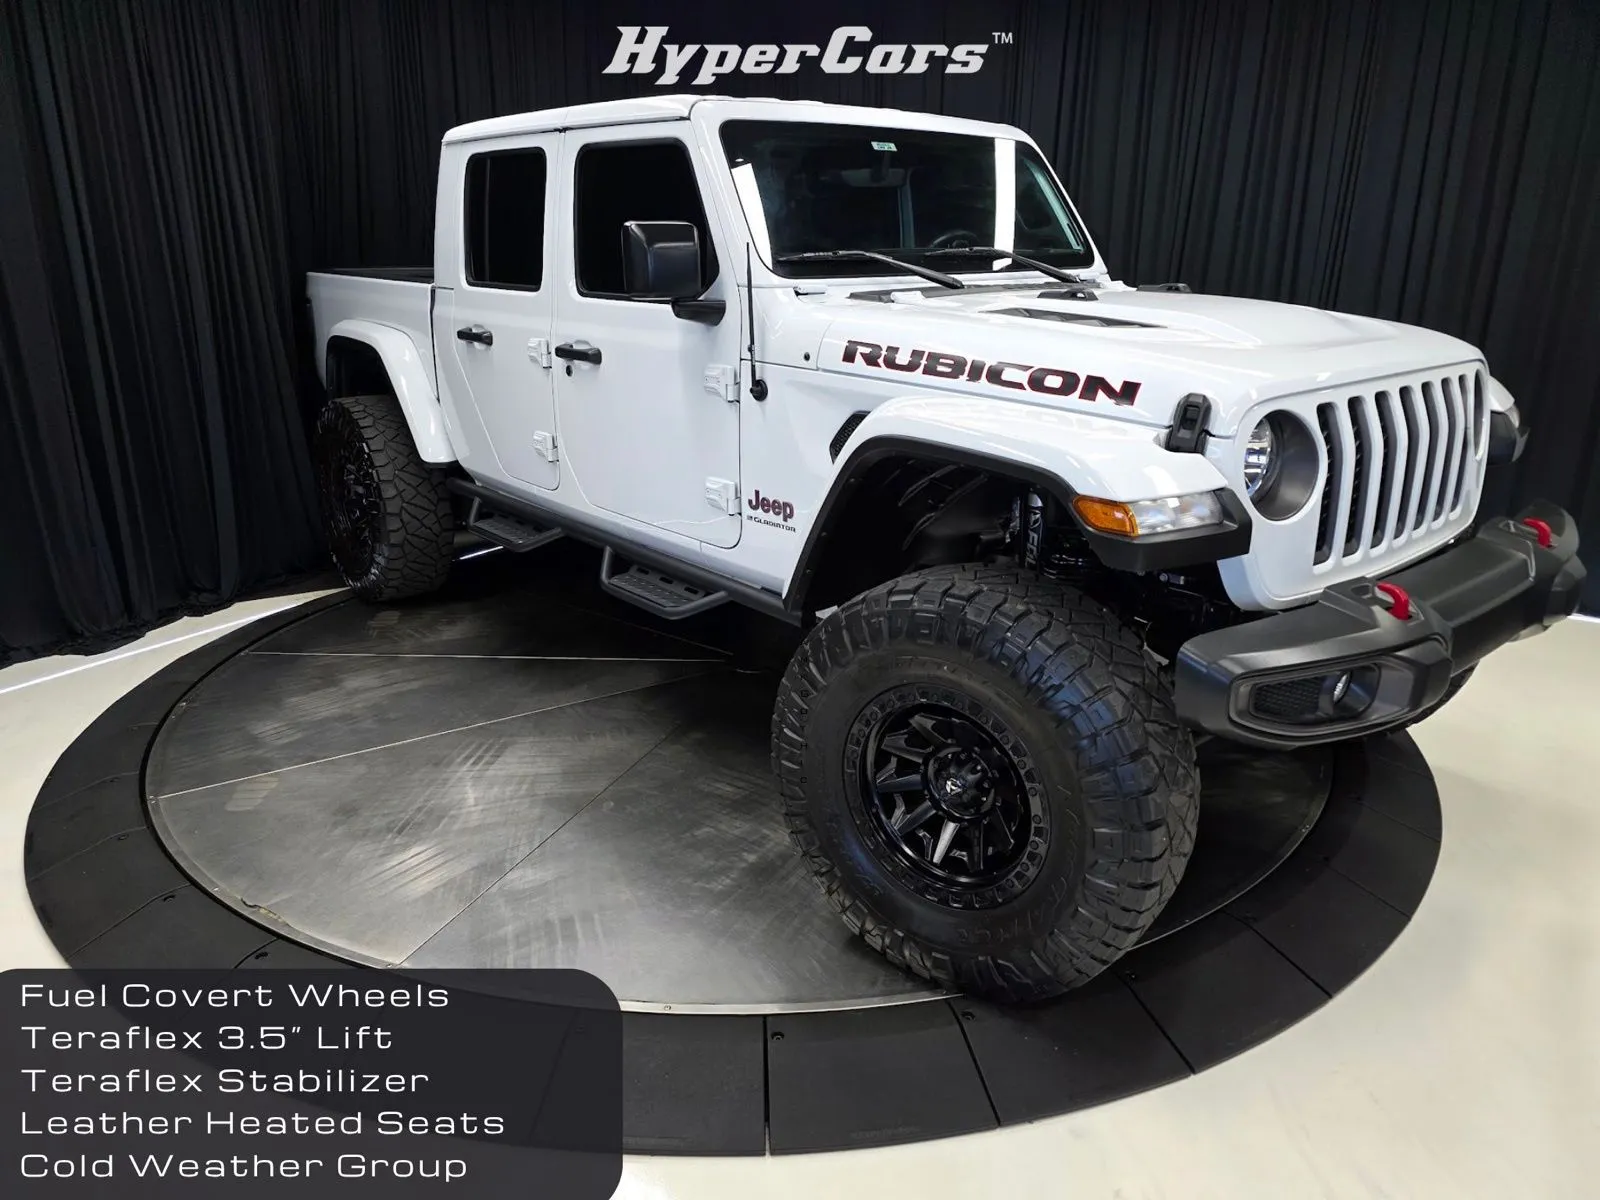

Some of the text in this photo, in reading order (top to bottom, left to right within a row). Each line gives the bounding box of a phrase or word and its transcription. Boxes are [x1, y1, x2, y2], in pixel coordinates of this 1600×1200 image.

[842, 340, 1142, 406] RUBICON
[748, 490, 794, 522] Jeep
[753, 516, 796, 533] GLADIATOR
